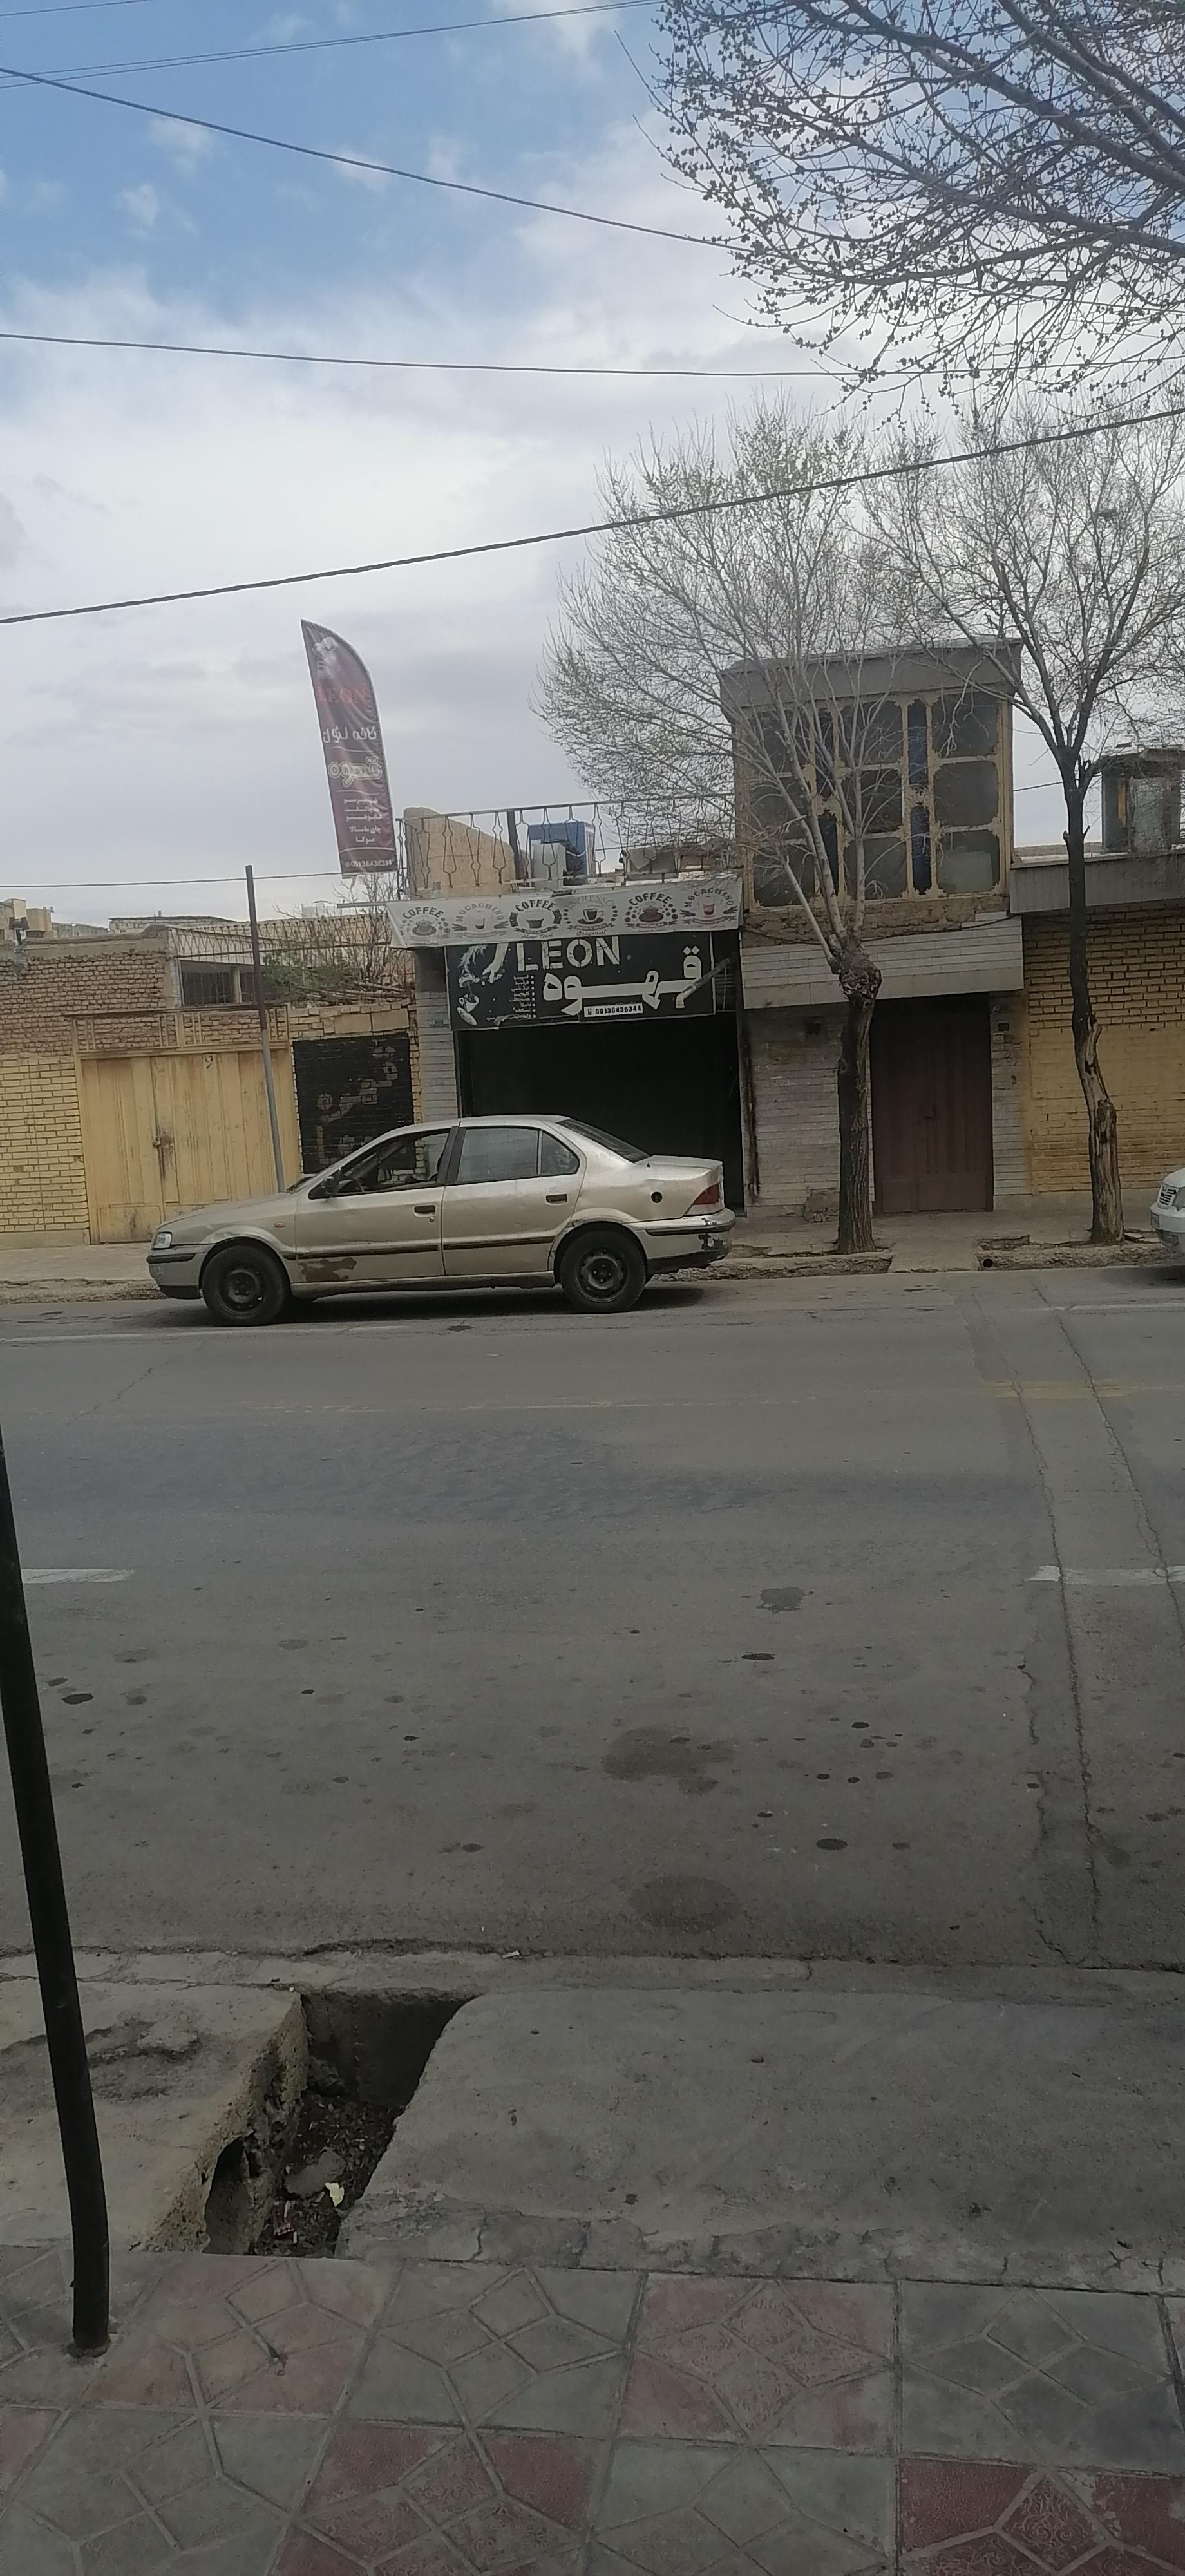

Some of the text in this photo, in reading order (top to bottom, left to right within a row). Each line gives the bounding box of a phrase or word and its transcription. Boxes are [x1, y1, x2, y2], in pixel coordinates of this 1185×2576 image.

[323, 725, 377, 743] کافه لئون
[328, 756, 383, 788] قهوه
[515, 899, 556, 912] COFFEE
[629, 893, 672, 906] COFFEE
[403, 906, 444, 919] COFFEE
[517, 936, 620, 971] LEON
[543, 945, 702, 1016] قهوه
